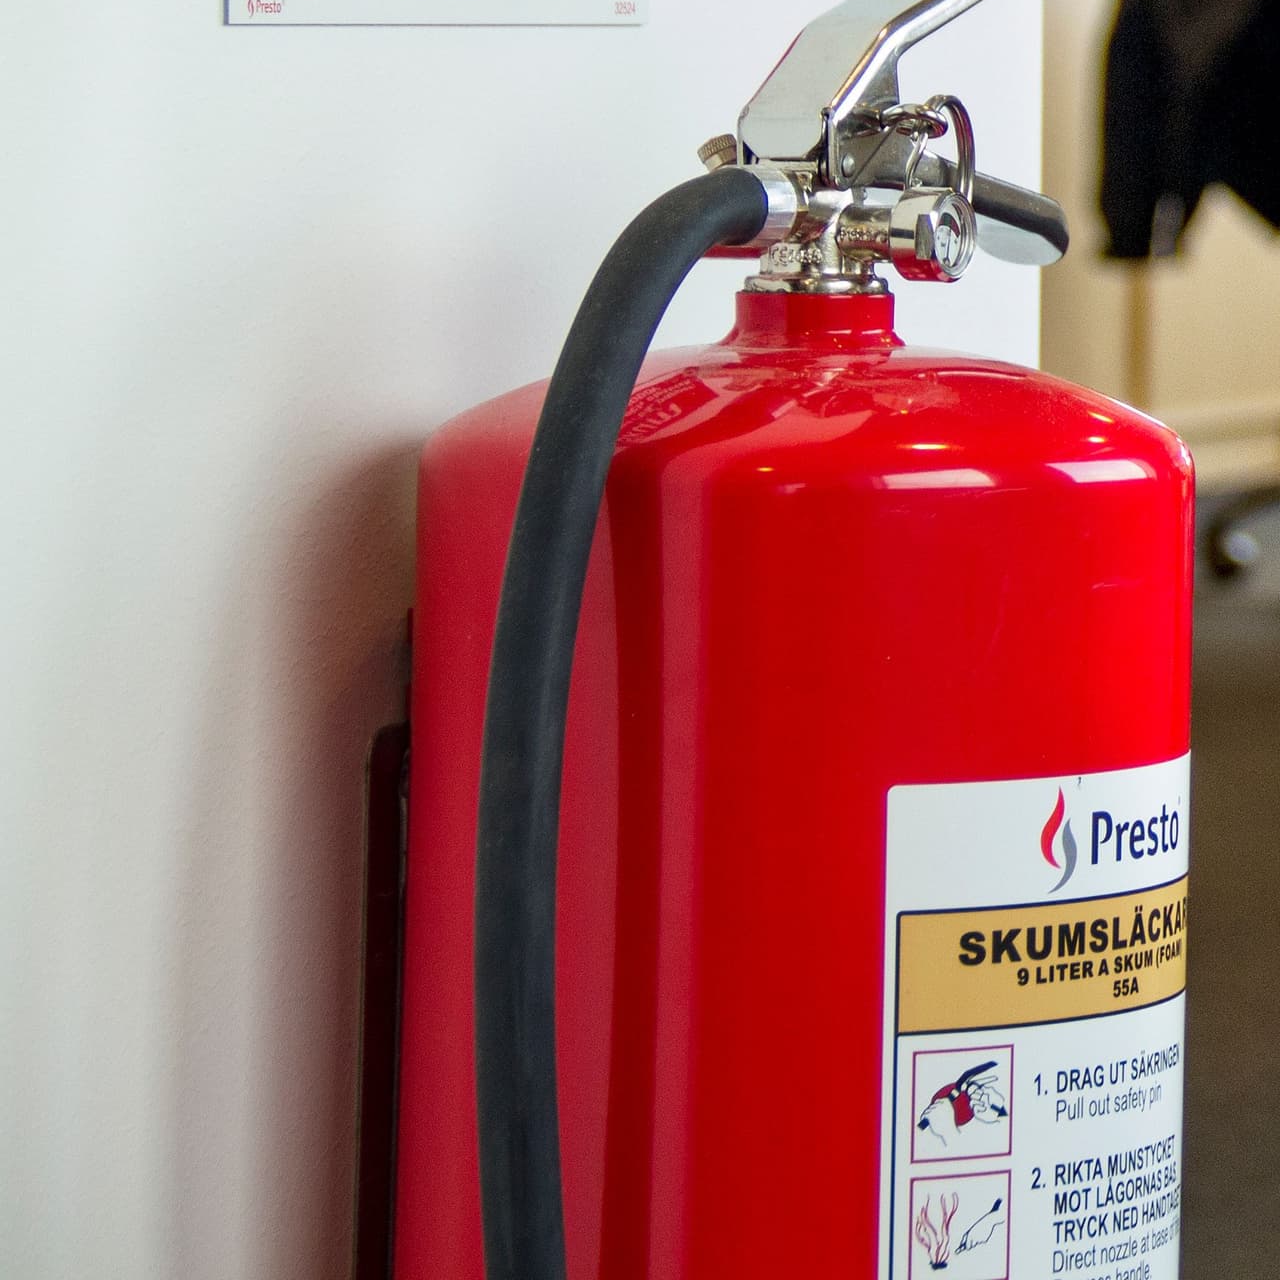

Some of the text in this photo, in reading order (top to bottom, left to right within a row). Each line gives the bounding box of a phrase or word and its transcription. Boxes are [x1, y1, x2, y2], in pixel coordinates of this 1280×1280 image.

[256, 0, 282, 13] Presto
[1090, 804, 1179, 865] Presto
[1017, 968, 1029, 986] 9
[1036, 960, 1094, 985] LITER
[1098, 958, 1109, 977] A
[1113, 949, 1153, 974] SKUM
[1113, 976, 1139, 998] 55A
[1033, 1073, 1048, 1097] 1.
[1056, 1065, 1105, 1093] DRAG
[1109, 1059, 1127, 1085] UT
[1056, 1081, 1162, 1122] Pull out safety pin
[1031, 1134, 1175, 1189] 2. RIKTA MUNSTYCKET
[1054, 1187, 1092, 1216] MOT
[1096, 1169, 1162, 1209] LÅGORNAS
[1053, 1213, 1108, 1244] TRYCK
[1113, 1206, 1138, 1233] NED
[1053, 1244, 1096, 1274] Direct
[1100, 1236, 1138, 1265] nozzle
[1141, 1232, 1149, 1254] at
